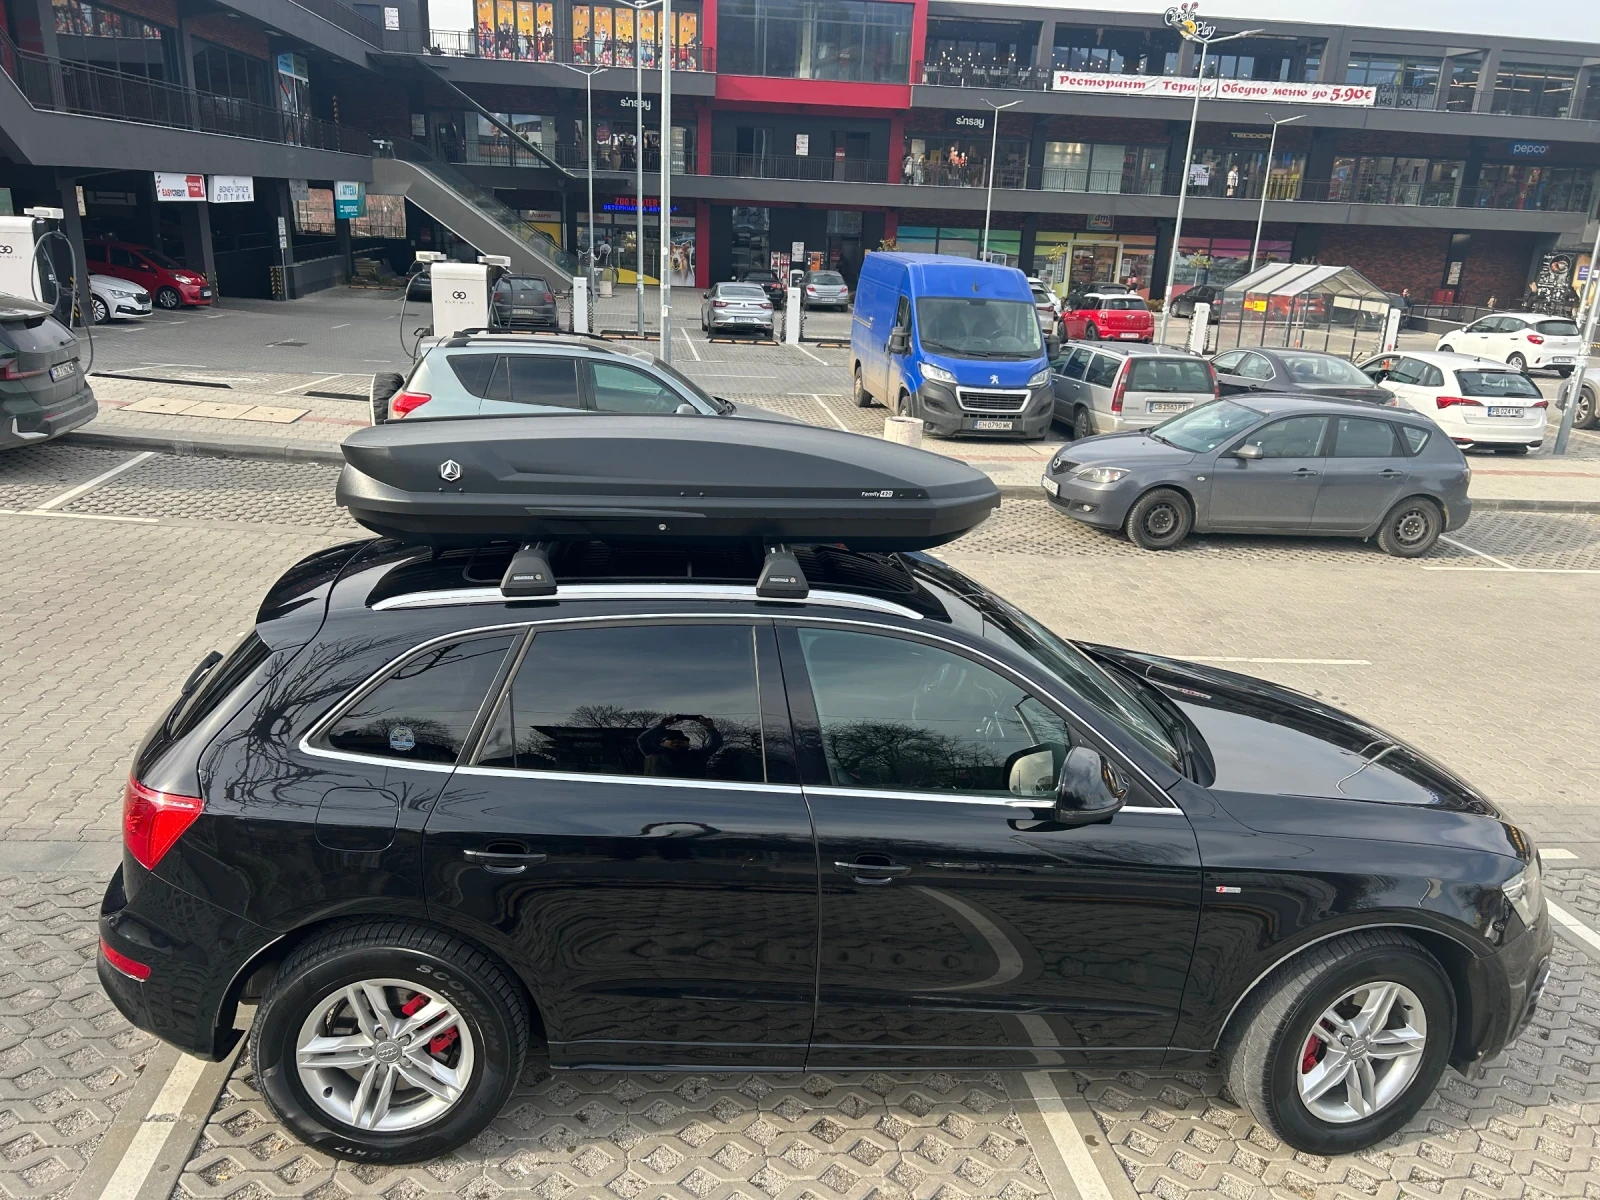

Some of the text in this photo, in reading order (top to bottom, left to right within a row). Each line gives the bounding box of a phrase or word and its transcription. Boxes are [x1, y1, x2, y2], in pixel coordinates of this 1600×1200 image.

[1195, 21, 1217, 40] Play
[1059, 75, 1146, 91] Ресторант
[1221, 83, 1268, 95] Обедно
[1272, 88, 1308, 97] меню
[1311, 89, 1328, 99] до
[1329, 87, 1372, 102] 5.90€
[955, 115, 985, 129] sinsay
[1513, 144, 1546, 154] pepco
[216, 193, 252, 202] ОПТИКА
[615, 197, 658, 207] ZOO CNTER
[415, 964, 501, 1053] SCORPION
